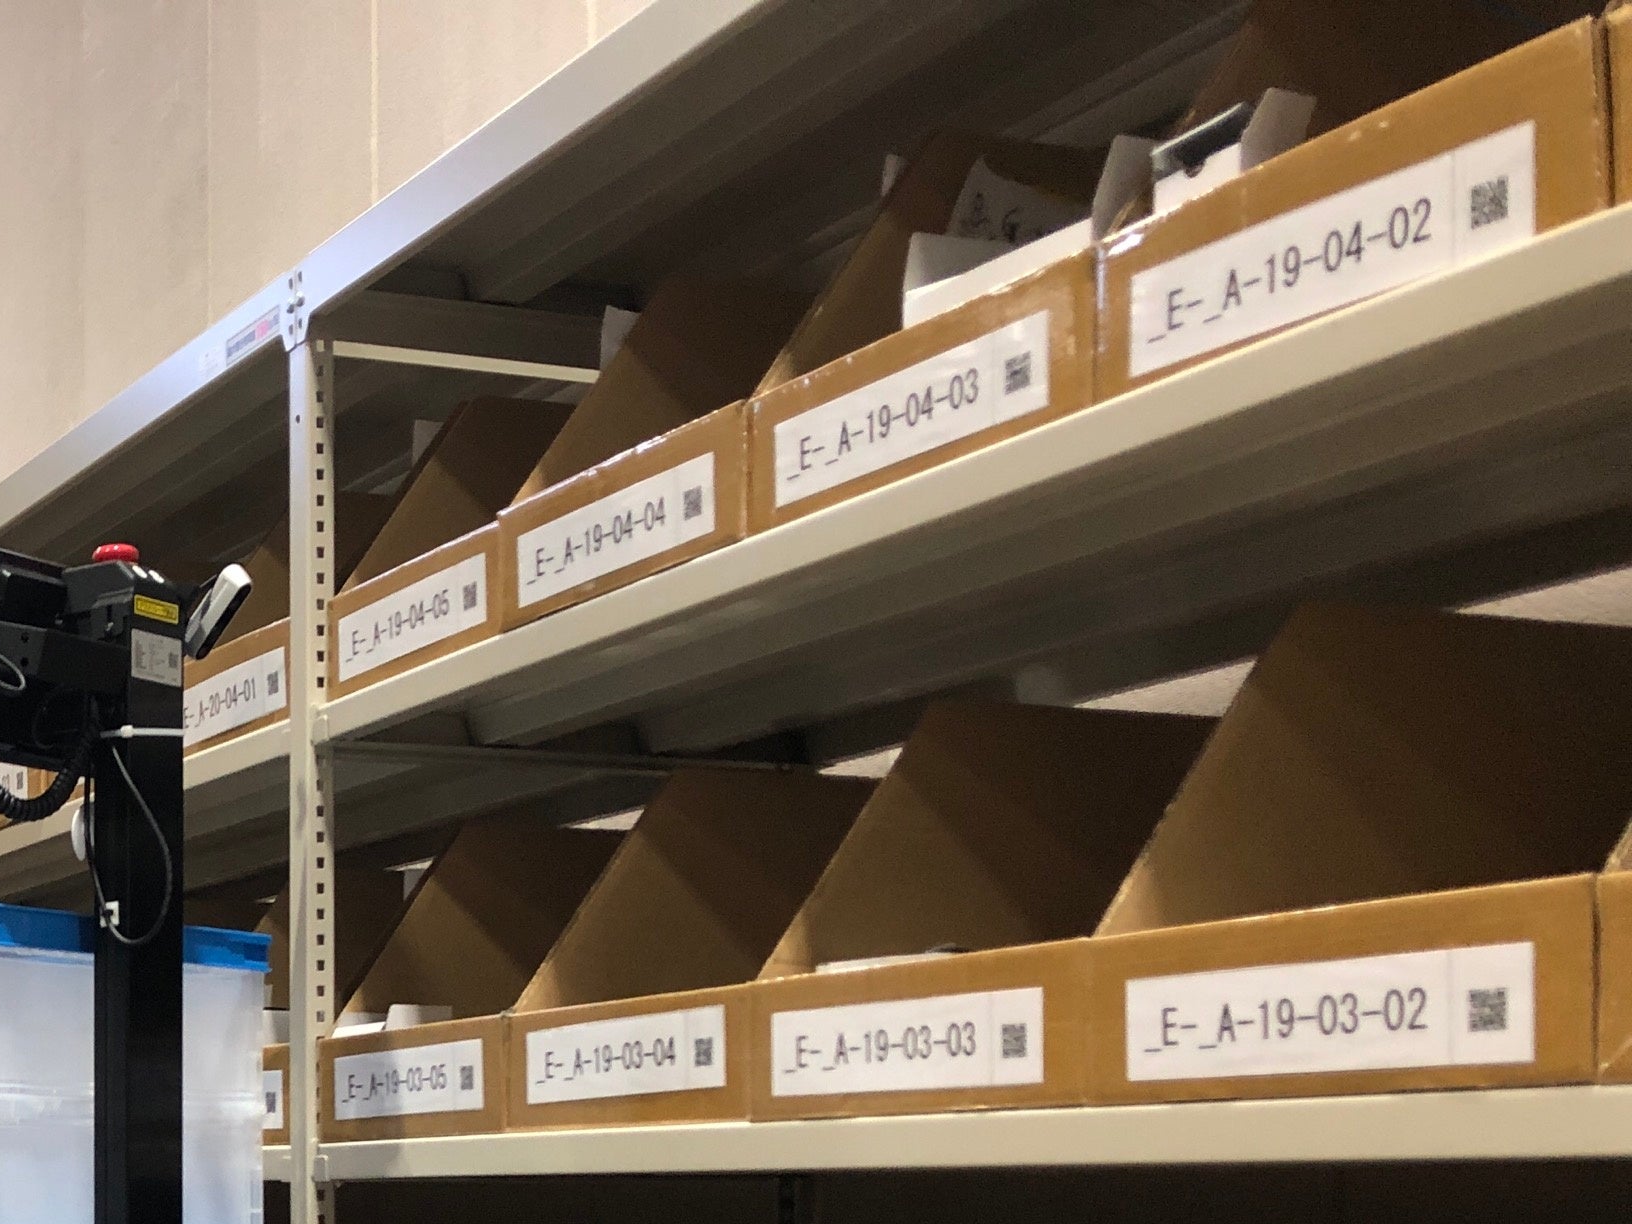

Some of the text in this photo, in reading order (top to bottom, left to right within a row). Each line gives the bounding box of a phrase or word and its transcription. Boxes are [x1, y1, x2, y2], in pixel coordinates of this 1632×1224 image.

[1147, 197, 1432, 343] _E-_A-19-04-02
[787, 368, 981, 482] _E-_A-19-04-03
[527, 494, 667, 586] _E-_A-19-04-04
[345, 587, 450, 664] _E-_A-19-04-05
[783, 1022, 978, 1075] _E-_A-19-03-03
[1143, 986, 1430, 1054] _E-_A-19-03-02
[341, 1064, 448, 1105] _E-_A-19-03-05
[536, 1036, 677, 1085] _E-_A-19-03-04
